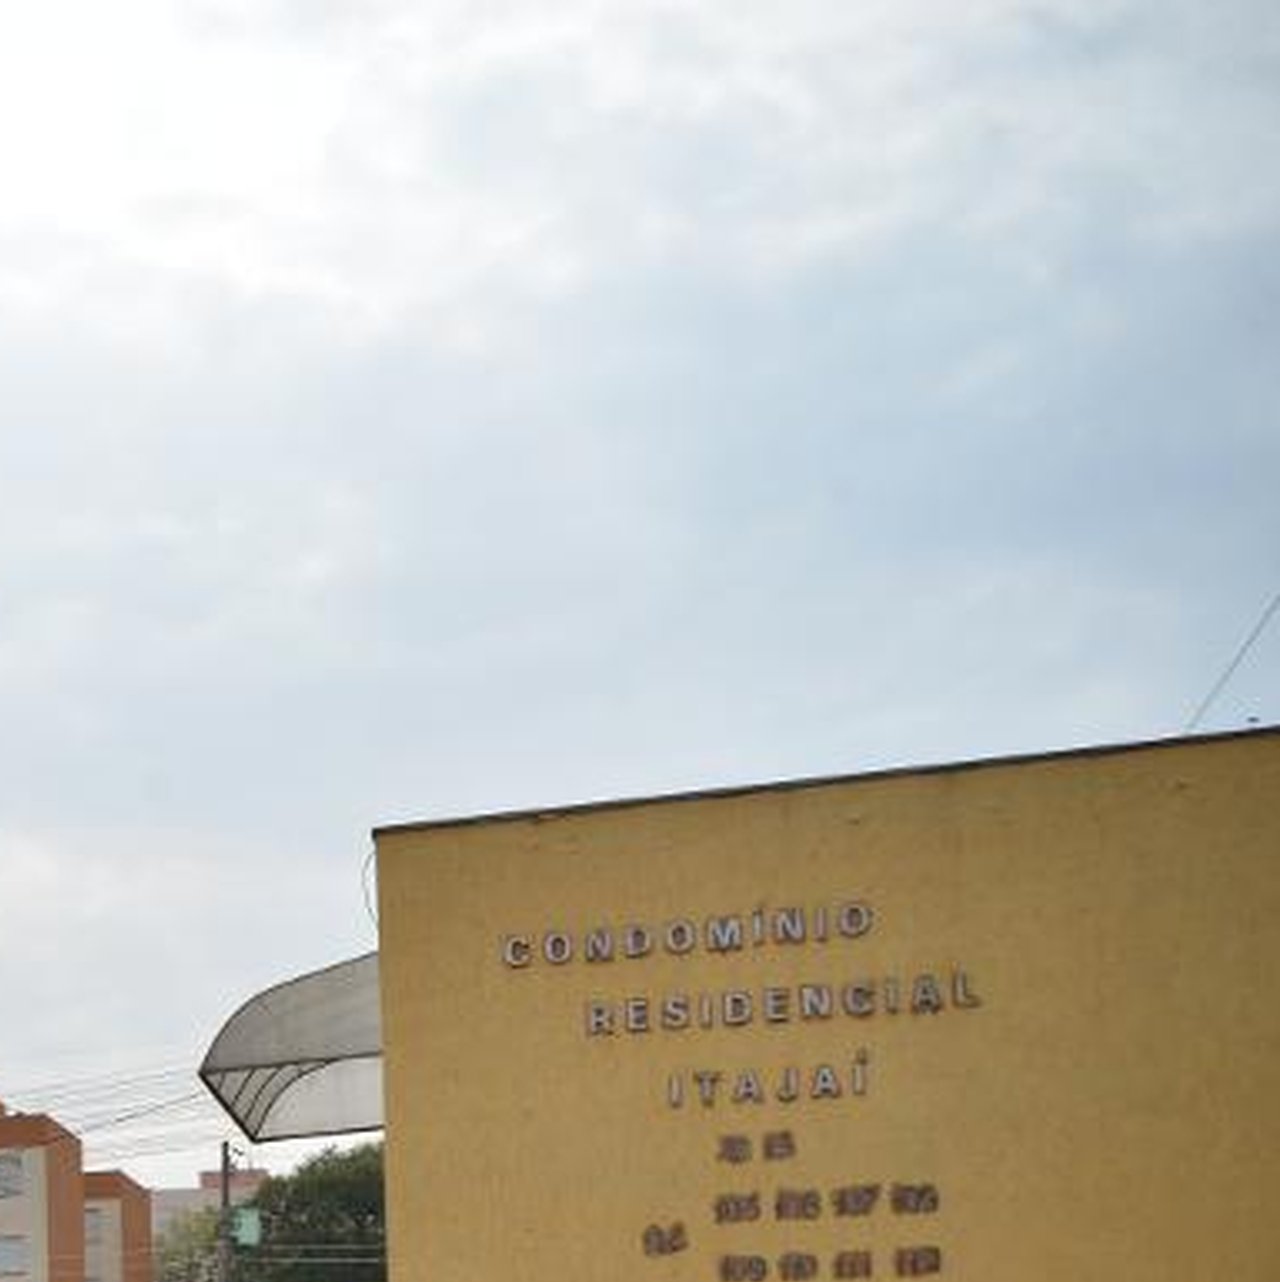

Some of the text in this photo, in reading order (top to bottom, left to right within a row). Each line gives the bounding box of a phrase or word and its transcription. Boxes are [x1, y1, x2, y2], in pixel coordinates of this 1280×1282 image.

[502, 900, 873, 967] CONDOMÍNIO
[586, 961, 981, 1036] RESIDENCIAL
[666, 1046, 871, 1107] ITAJAÍ
